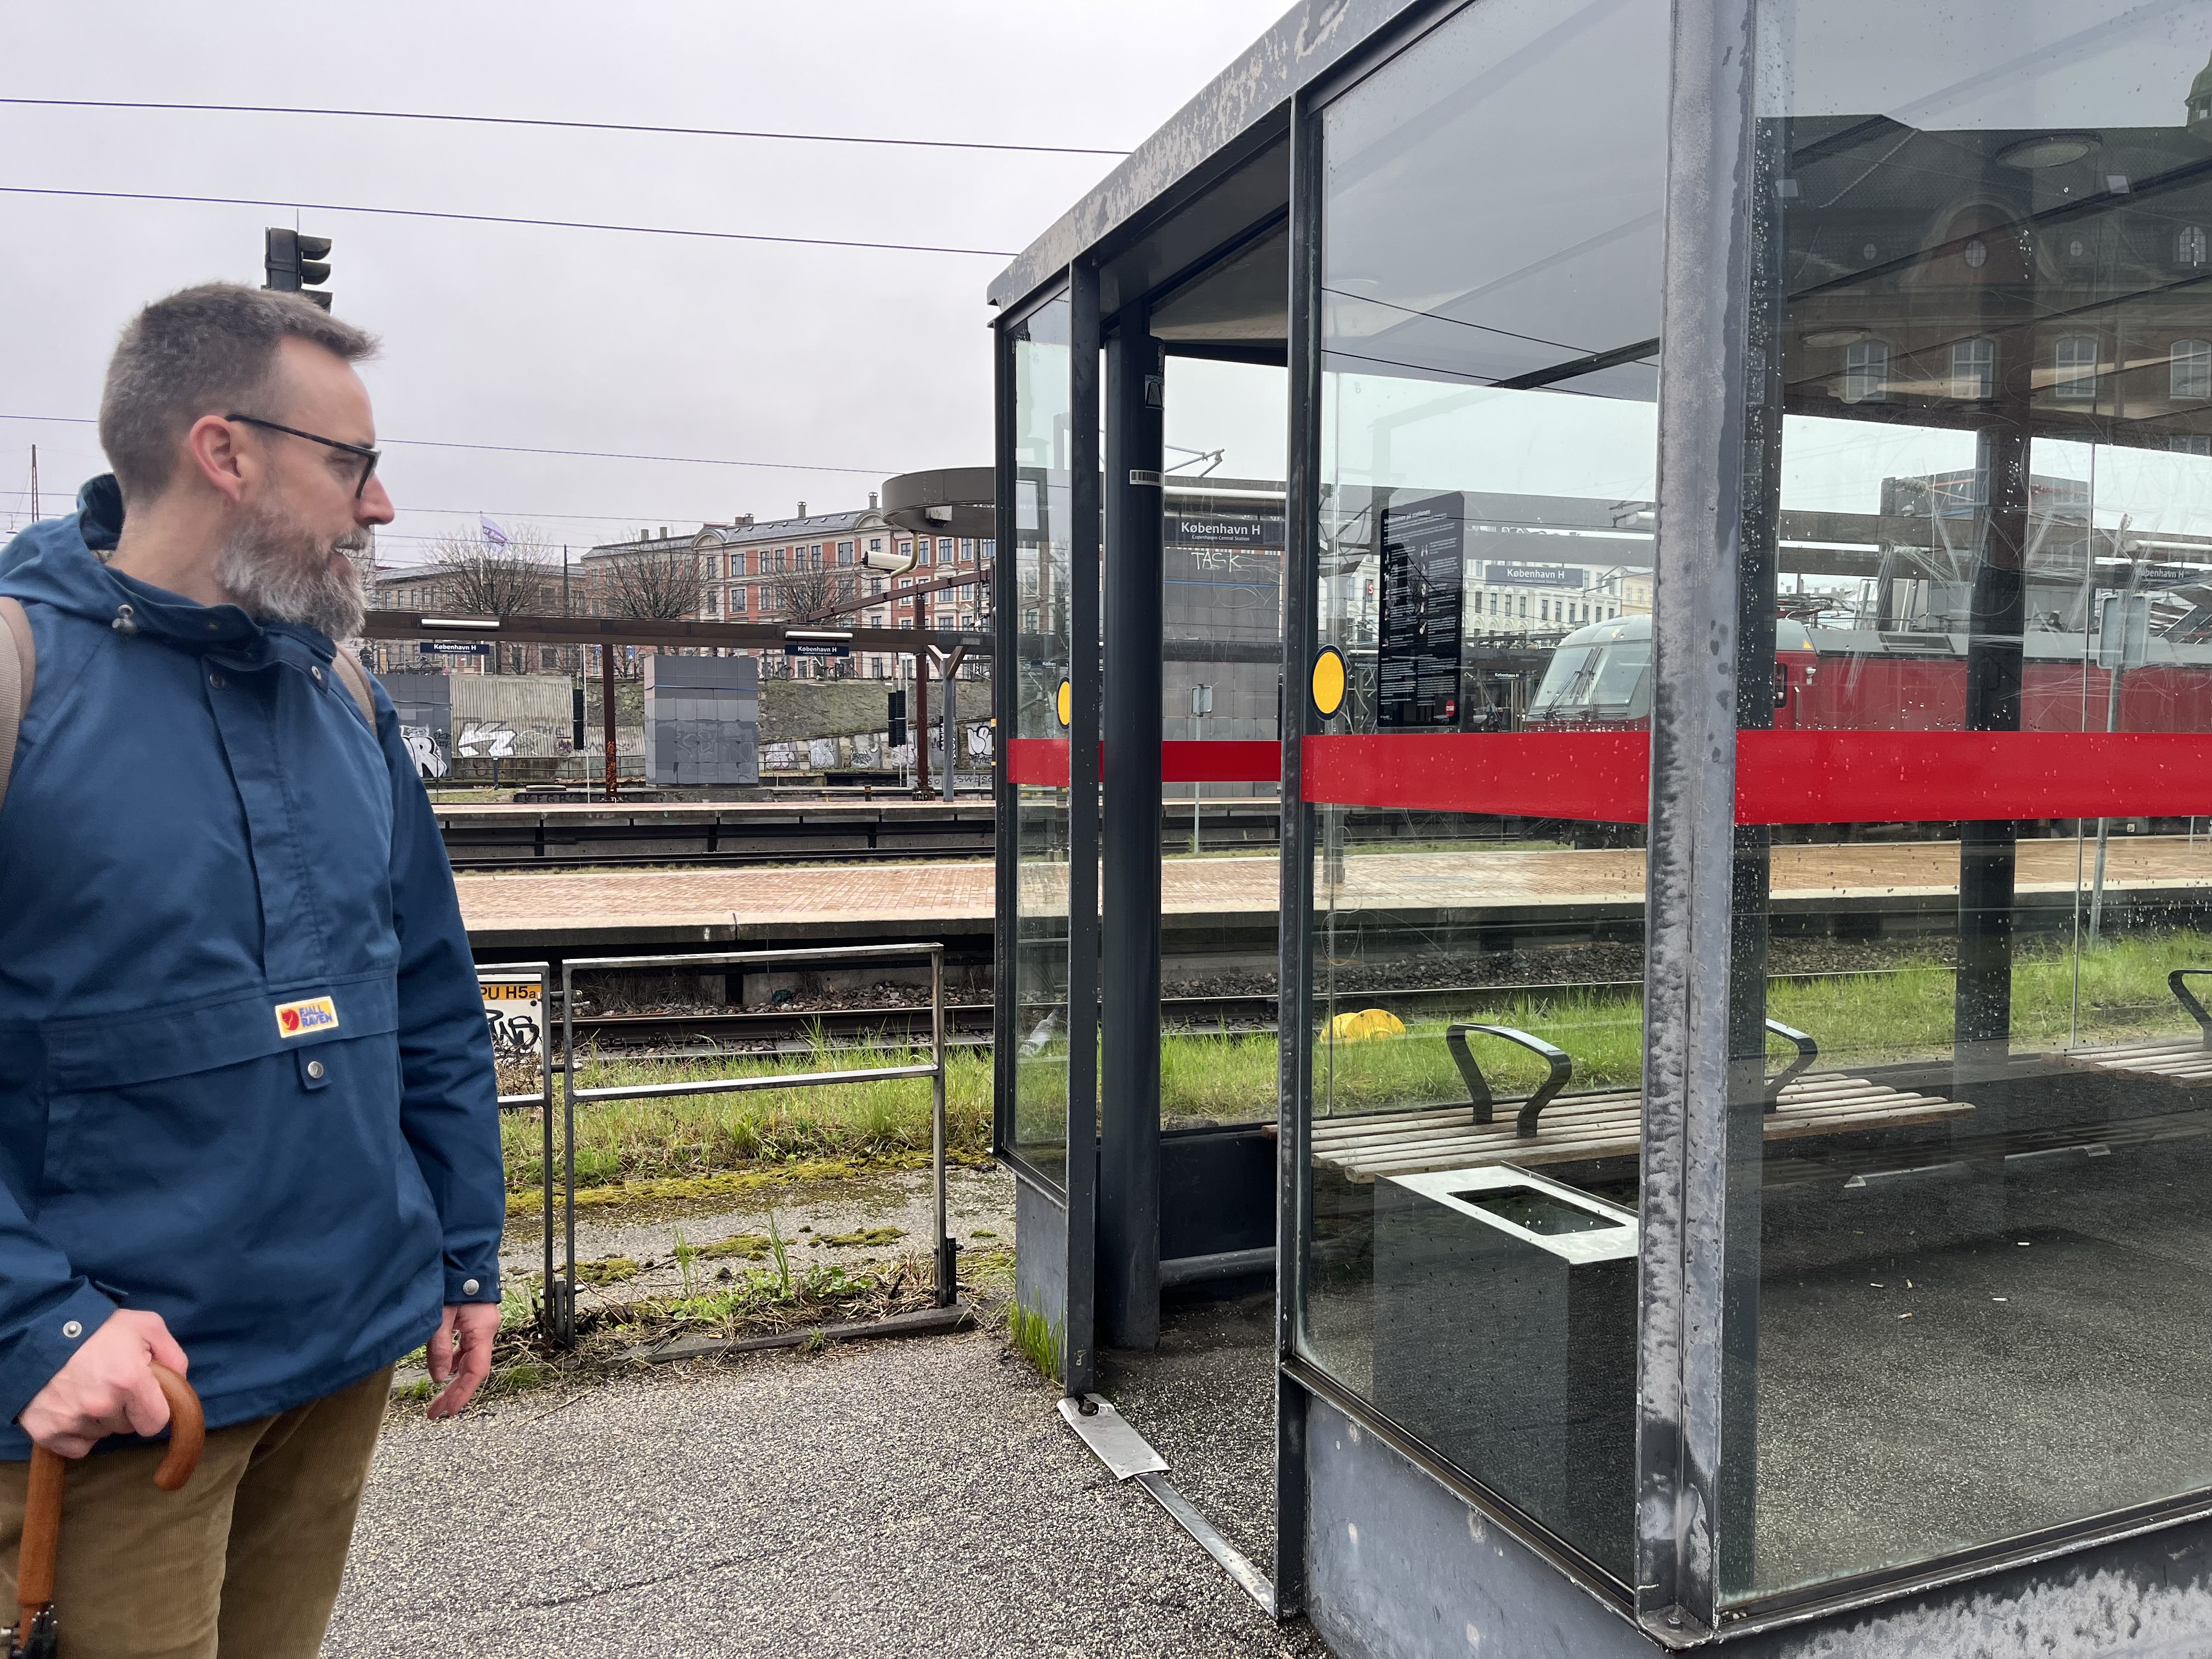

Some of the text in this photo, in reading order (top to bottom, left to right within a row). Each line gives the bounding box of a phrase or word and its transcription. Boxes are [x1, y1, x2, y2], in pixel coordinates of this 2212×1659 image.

[1181, 522, 1260, 535] København H
[1191, 549, 1242, 573] TASK
[1507, 568, 1565, 579] København H
[2136, 568, 2185, 578] benhavn H
[1369, 584, 1374, 594] S
[506, 986, 536, 999] H5a
